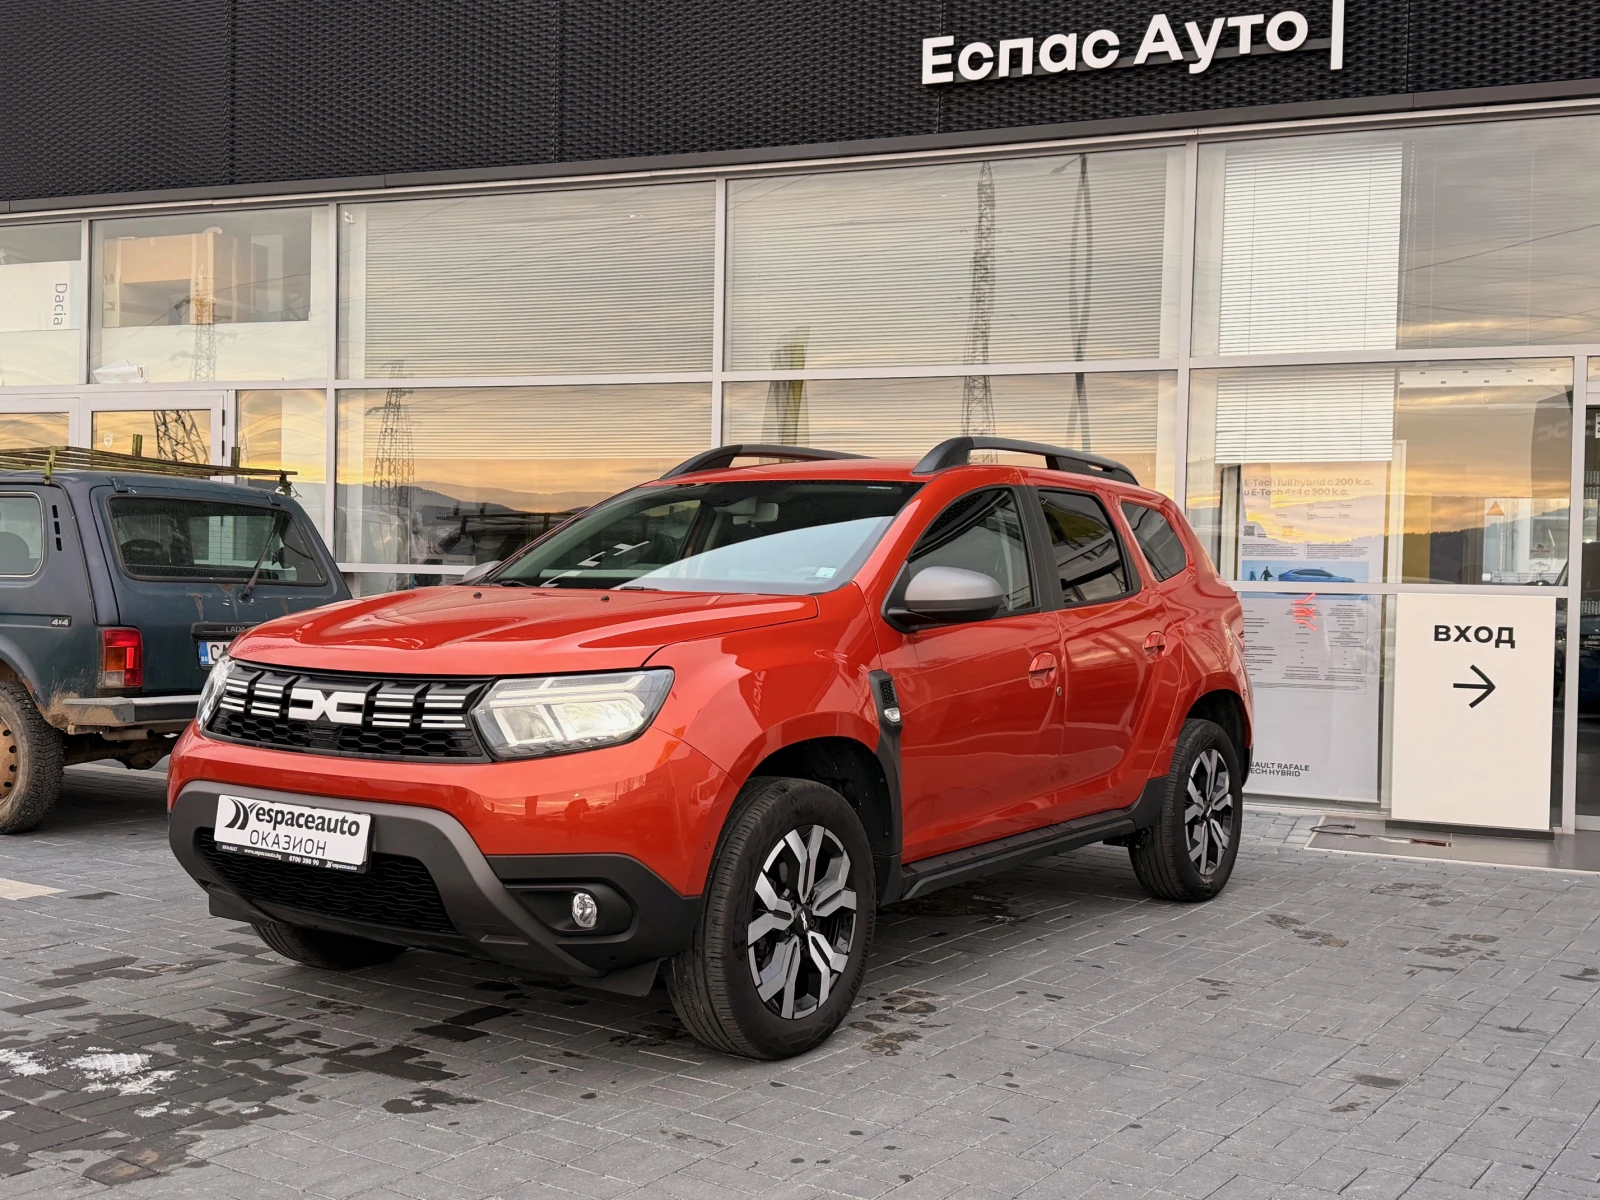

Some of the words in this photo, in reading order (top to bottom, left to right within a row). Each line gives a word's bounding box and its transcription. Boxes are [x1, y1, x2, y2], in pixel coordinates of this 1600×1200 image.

[921, 29, 1120, 85] Еспас
[1133, 10, 1309, 74] Ауто
[53, 282, 68, 326] Dacia
[1244, 479, 1276, 487] E-Tech
[1277, 478, 1293, 487] full
[1294, 478, 1326, 488] hybrid
[1335, 478, 1354, 486] 200
[1251, 488, 1283, 496] E-Tech
[1284, 488, 1303, 496] 4x4
[1311, 488, 1331, 496] 300
[51, 618, 69, 626] 4x4
[1277, 762, 1310, 771] RAFALE
[1268, 769, 1301, 777] HYBRID
[255, 806, 360, 836] espaceauto
[249, 829, 327, 857] ОКАЗИОН
